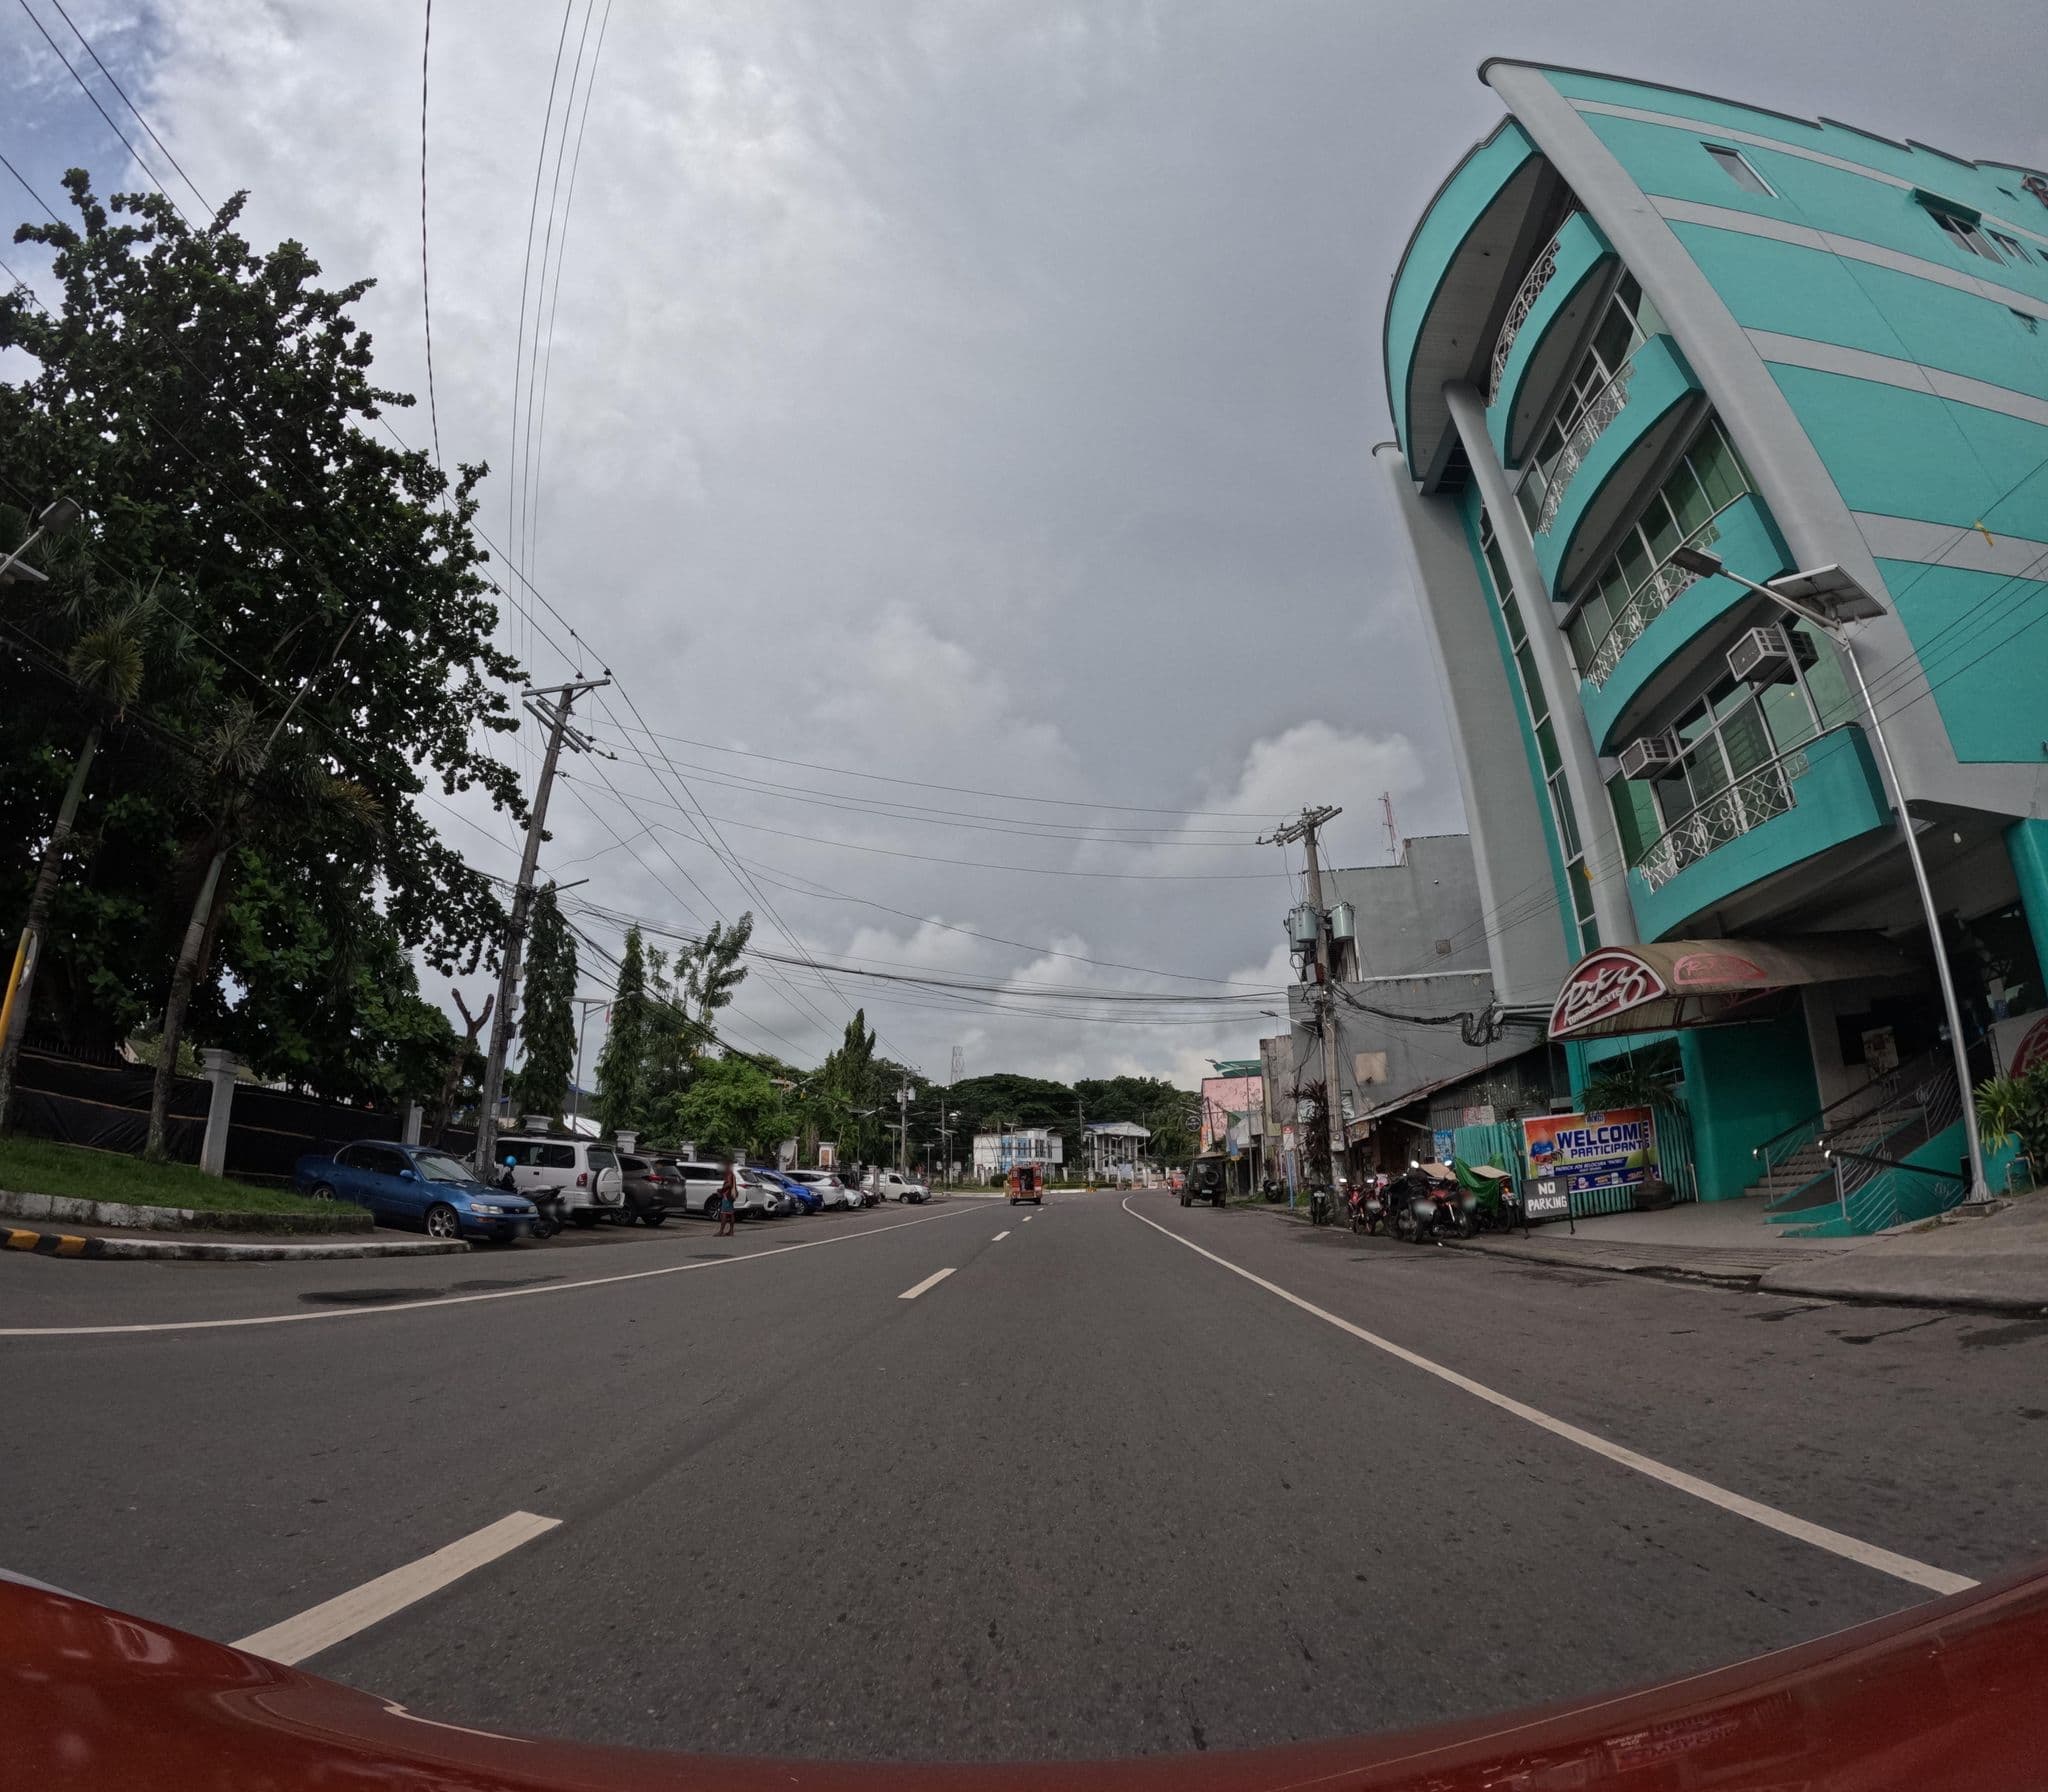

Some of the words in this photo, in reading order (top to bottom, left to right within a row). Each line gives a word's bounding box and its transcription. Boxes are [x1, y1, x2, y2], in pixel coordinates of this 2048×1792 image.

[1557, 1122, 1649, 1150] WELCOME
[1571, 1141, 1649, 1158] PARTICIPANTS
[1538, 1182, 1556, 1195] NO
[1528, 1196, 1568, 1212] PARKING
